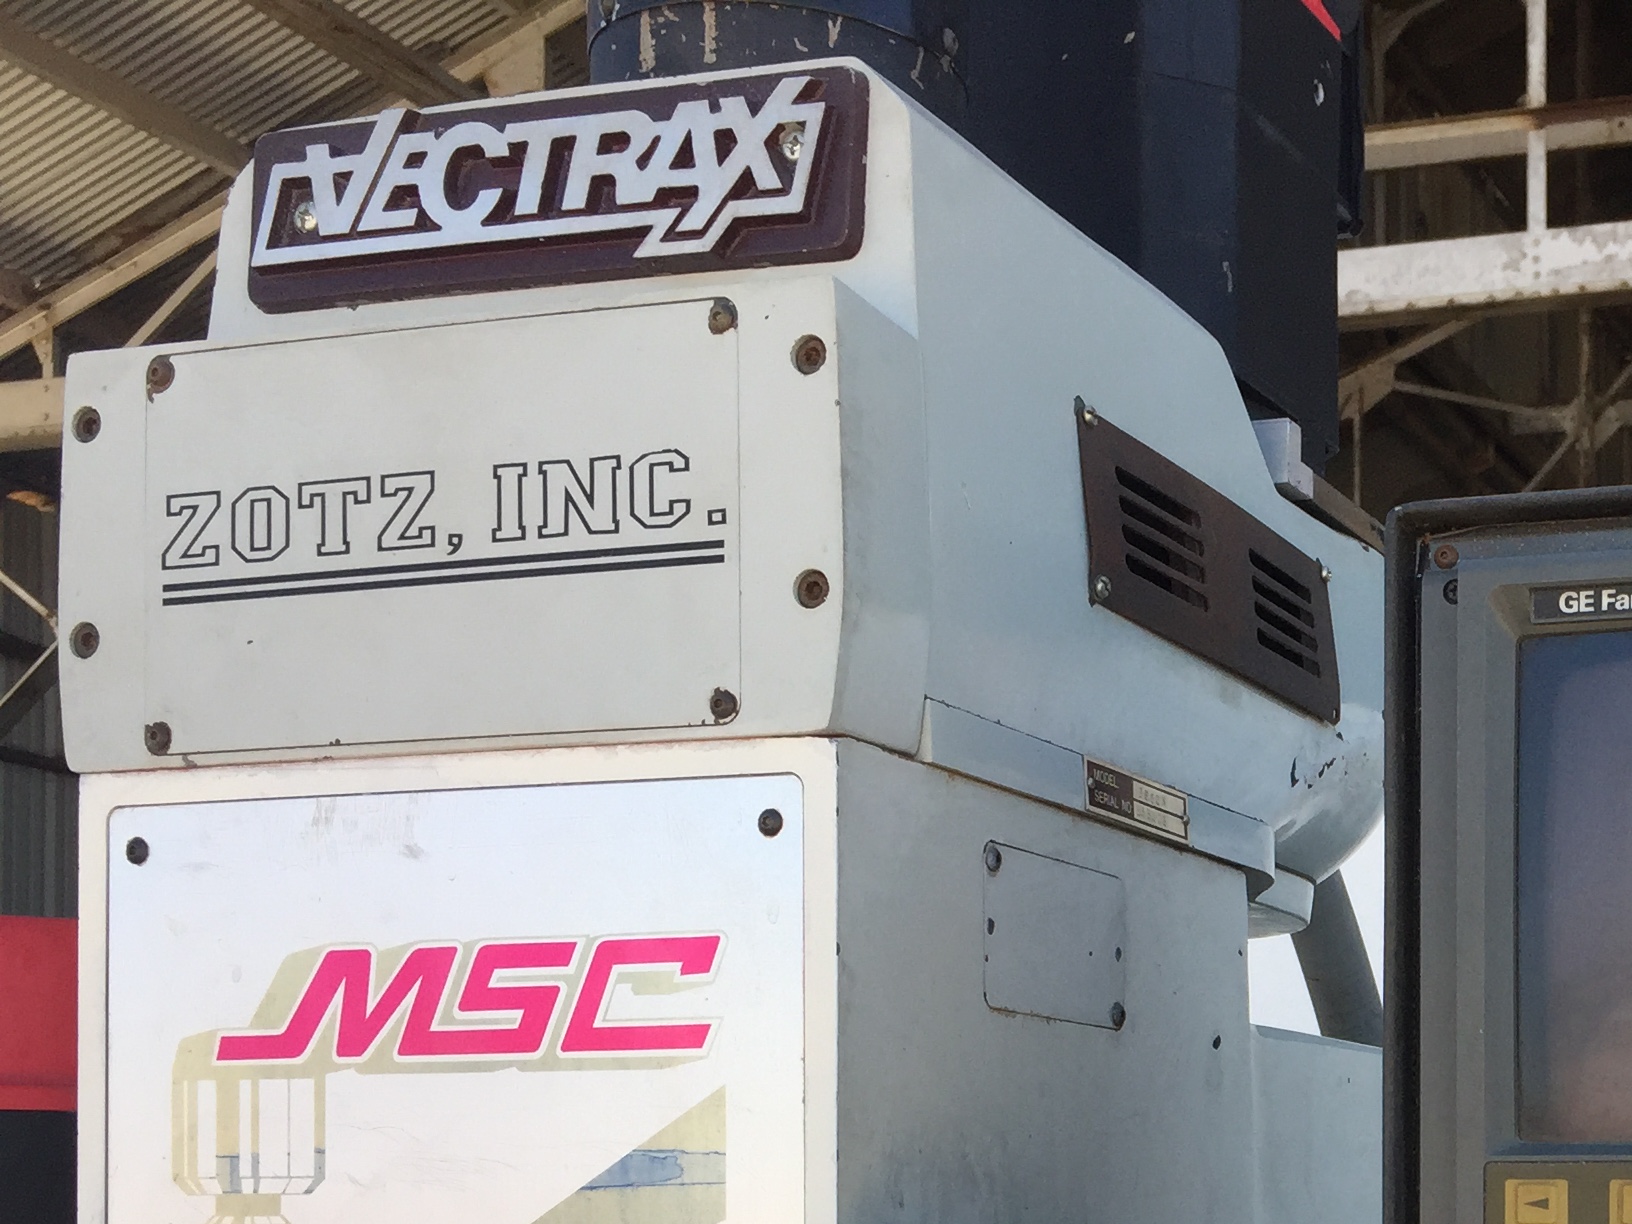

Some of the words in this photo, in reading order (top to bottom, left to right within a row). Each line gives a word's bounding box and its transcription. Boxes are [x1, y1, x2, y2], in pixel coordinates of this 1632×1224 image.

[300, 76, 815, 262] VECTRAX
[161, 471, 465, 571] ZOTZ,
[491, 447, 728, 543] INC.
[1558, 589, 1595, 614] GE
[1094, 789, 1119, 810] SERIAL
[214, 932, 723, 1063] MSC
